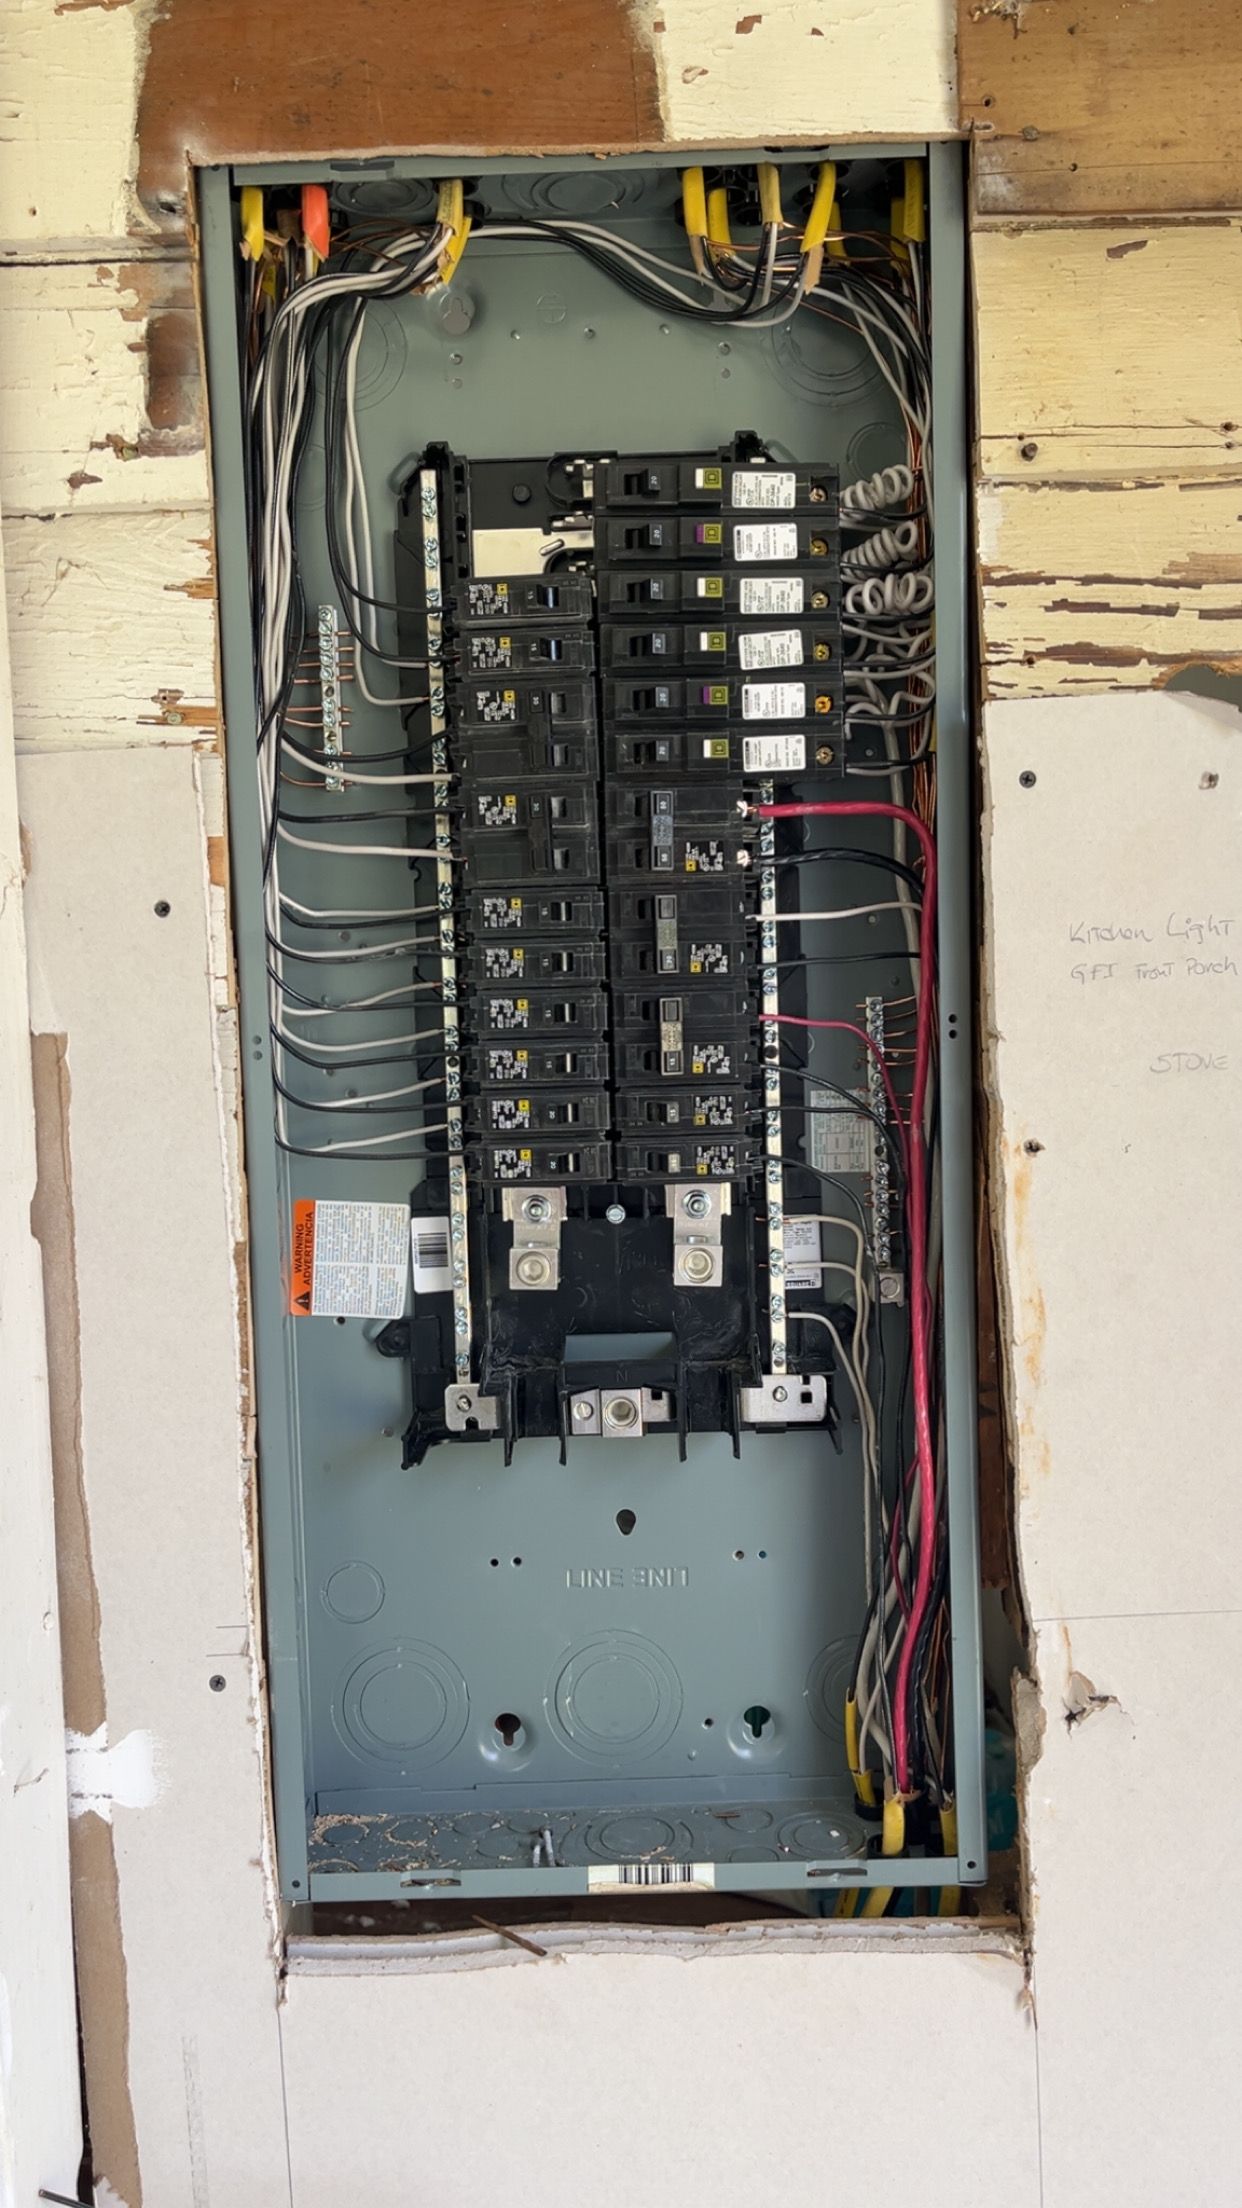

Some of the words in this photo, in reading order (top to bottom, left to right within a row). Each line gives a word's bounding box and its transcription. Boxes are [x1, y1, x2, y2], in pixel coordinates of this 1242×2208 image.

[1071, 963, 1118, 985] GFI
[1185, 957, 1238, 977] Porch
[1149, 1053, 1229, 1074] STOVE
[295, 1224, 304, 1274] WARNING
[304, 1212, 314, 1285] ADVERTENCIA
[566, 1568, 624, 1589] LINE
